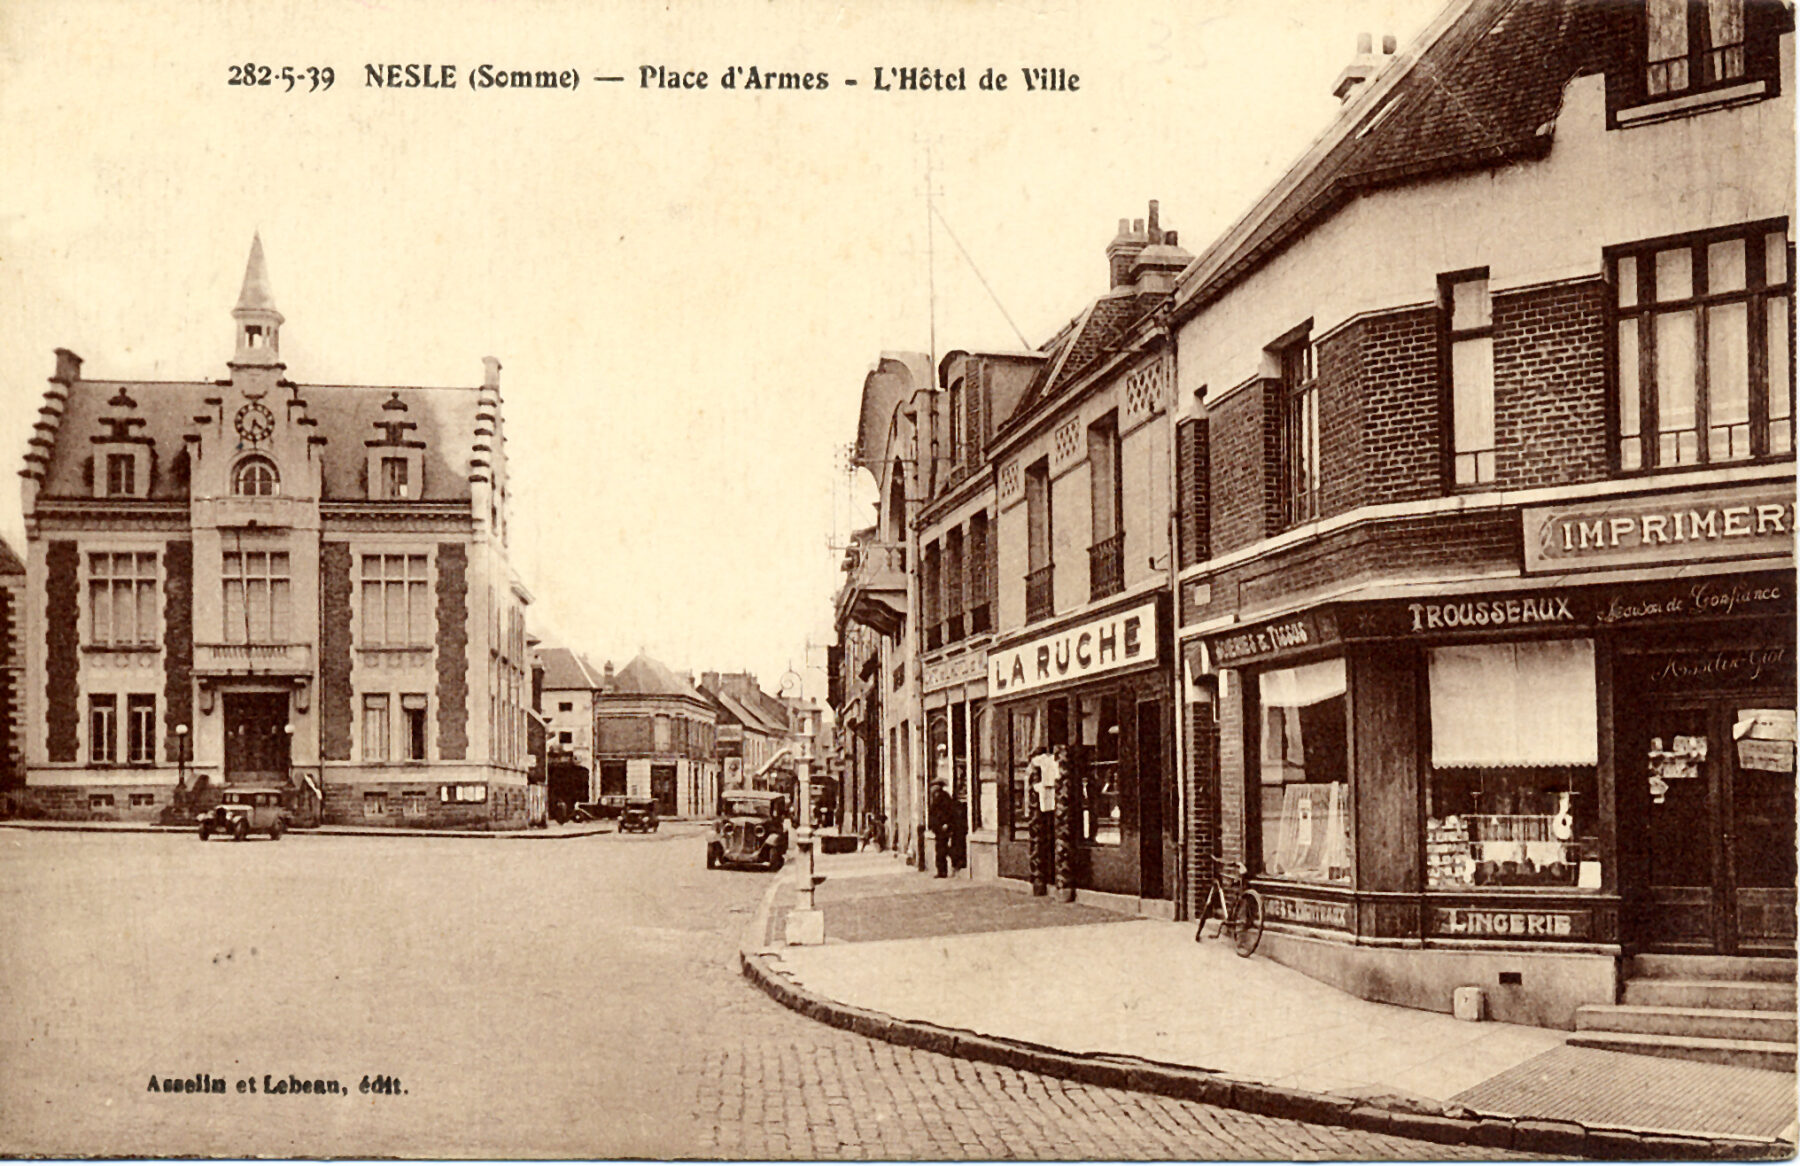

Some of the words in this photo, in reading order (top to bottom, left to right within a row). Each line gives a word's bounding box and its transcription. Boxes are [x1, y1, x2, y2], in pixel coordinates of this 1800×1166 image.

[1408, 597, 1574, 633] TROUSSEAUX
[996, 653, 1025, 690] LA
[1036, 615, 1141, 682] RUCHE
[1448, 908, 1572, 937] LINGERIE
